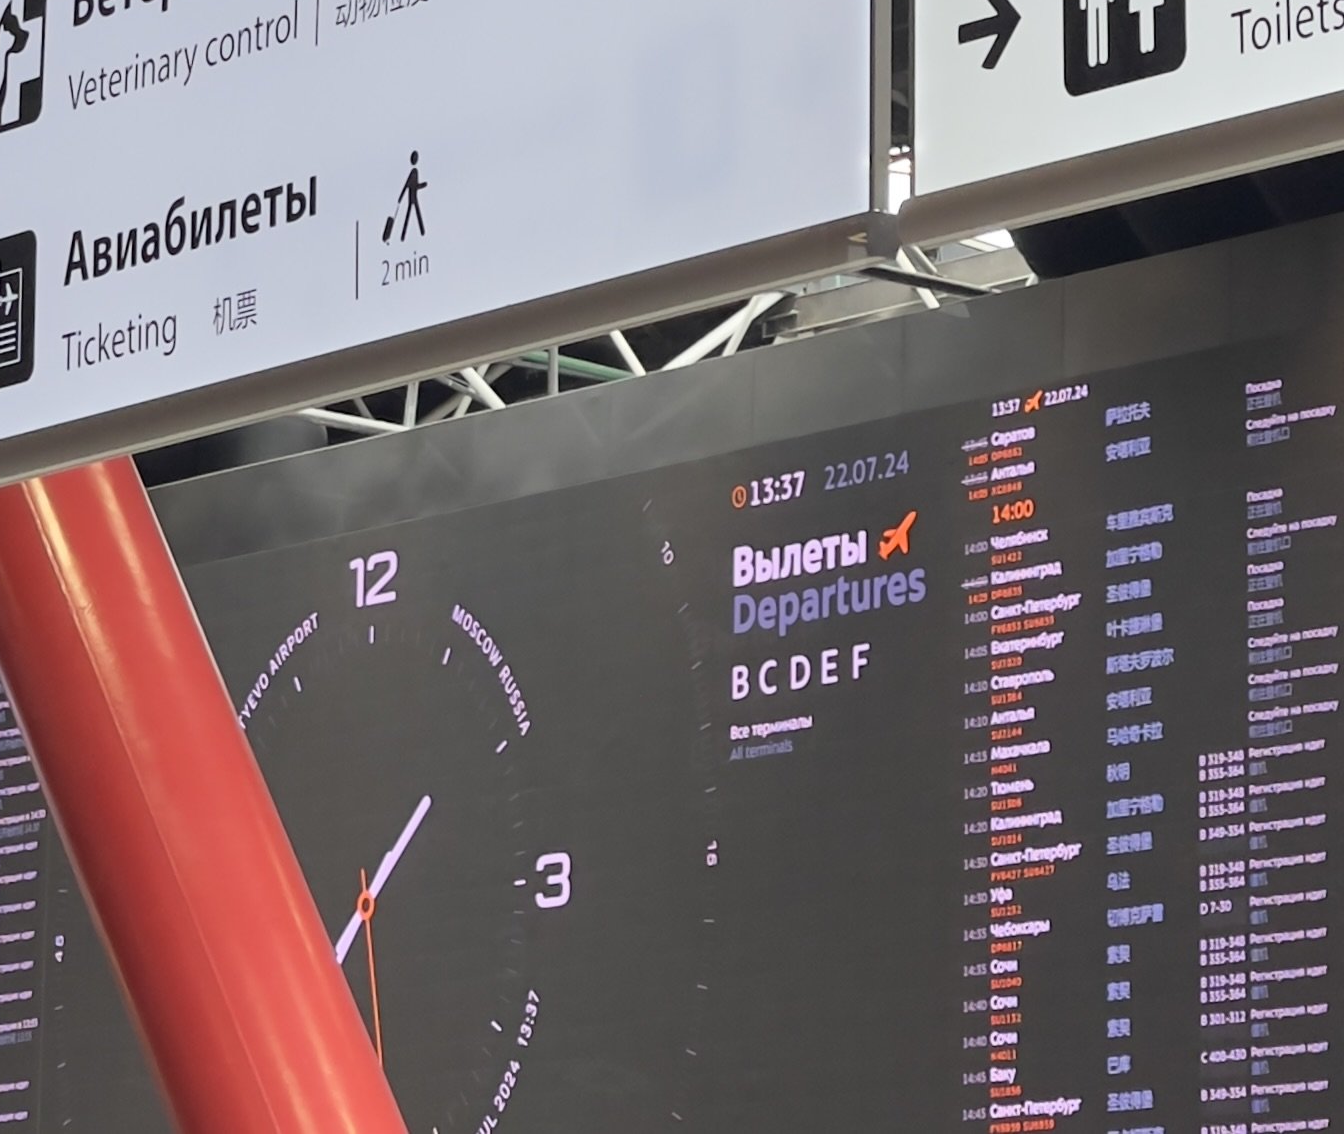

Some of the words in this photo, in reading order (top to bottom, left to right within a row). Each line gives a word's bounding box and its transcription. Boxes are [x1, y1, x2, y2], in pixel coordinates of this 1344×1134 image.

[69, 45, 197, 109] Veterinary
[206, 0, 297, 66] control
[64, 176, 316, 286] Авиабилеты
[382, 260, 389, 286] 2
[396, 252, 428, 281] min
[213, 289, 256, 334] 机票
[62, 314, 176, 370] Ticketing
[750, 471, 806, 507] 13:37
[824, 450, 910, 491] 22.07.24
[993, 500, 1033, 523] 14:00
[349, 550, 399, 608] 12
[733, 530, 868, 587] Вылеты
[733, 568, 927, 637] Departures
[268, 612, 319, 676] AIRPORT
[451, 604, 503, 667] MOSCOW
[498, 665, 532, 737] RUSSIA
[731, 665, 751, 701] B
[758, 659, 778, 695] C
[790, 654, 812, 690] D
[821, 648, 840, 685] E
[852, 643, 871, 679] F
[729, 724, 751, 741] Все
[729, 746, 744, 762] All
[744, 737, 794, 759] terminals
[535, 852, 573, 909] 3
[493, 1060, 521, 1114] 2024
[517, 989, 540, 1047] 13:37
